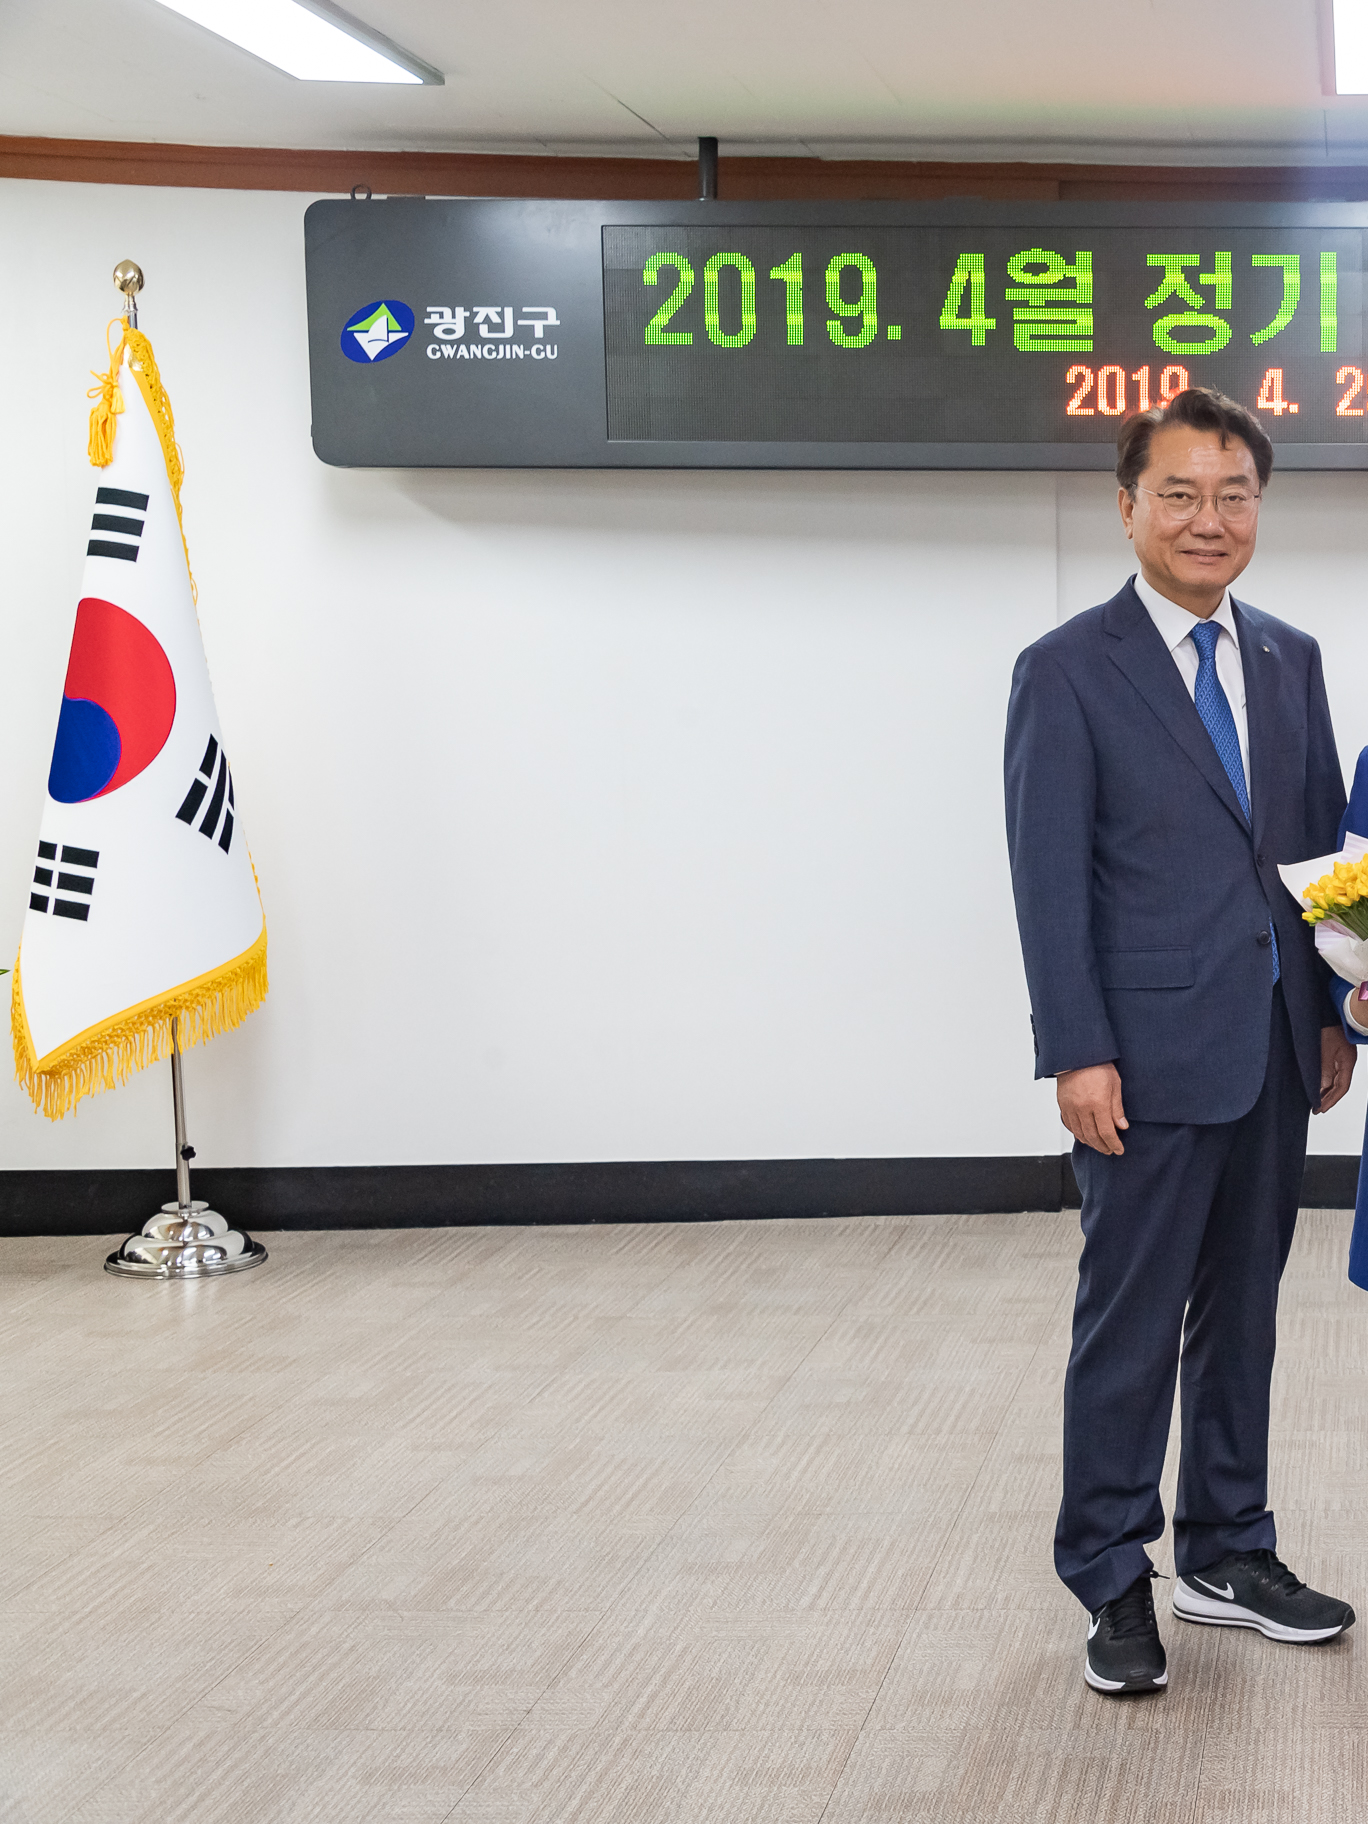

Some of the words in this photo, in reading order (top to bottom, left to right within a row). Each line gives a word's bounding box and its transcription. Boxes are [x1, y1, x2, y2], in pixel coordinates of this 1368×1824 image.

[643, 252, 901, 348] 2019.
[940, 248, 1093, 353] 4월
[1144, 251, 1337, 355] 정기
[424, 306, 560, 340] 광진구
[426, 344, 558, 359] GWANGJIN-GU
[1257, 368, 1299, 416] 4.
